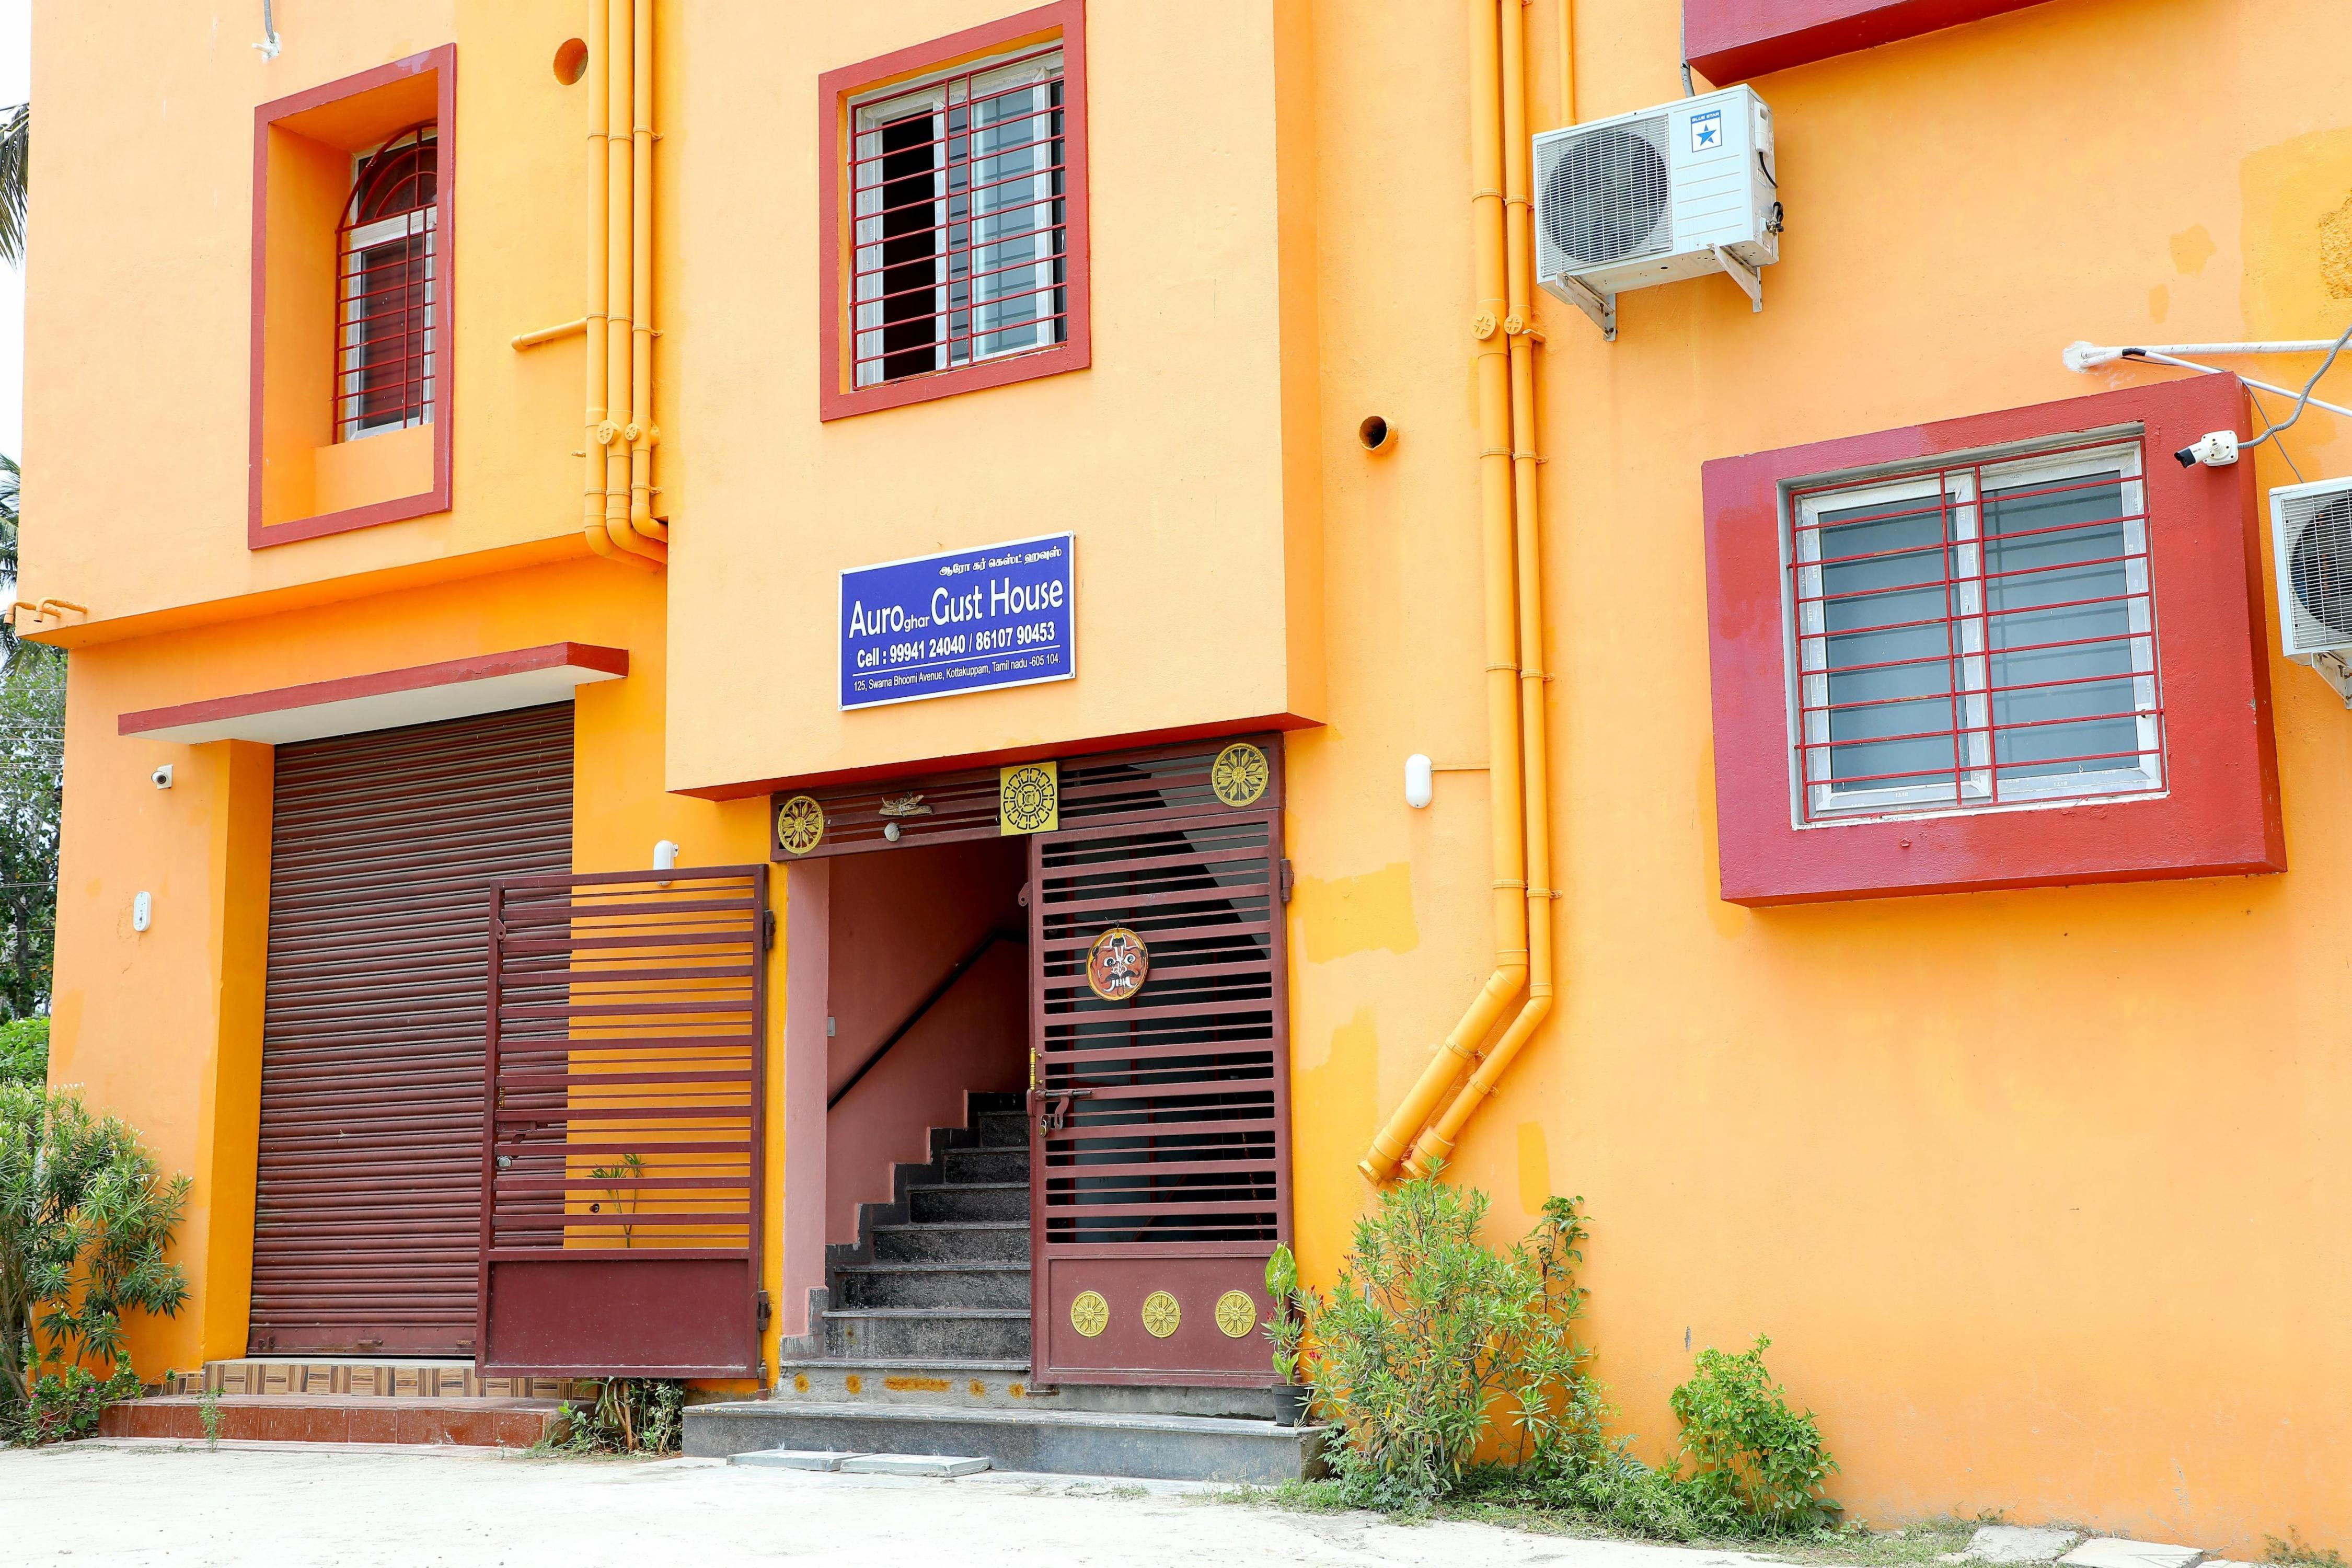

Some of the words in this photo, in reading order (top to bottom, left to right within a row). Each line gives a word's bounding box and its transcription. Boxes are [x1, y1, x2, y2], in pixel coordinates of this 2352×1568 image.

[939, 563, 971, 576] ஆரோ
[972, 558, 986, 571] கர்
[988, 554, 1023, 568] கெஸ்ட்
[931, 585, 983, 626] Gust
[990, 577, 1064, 617] House
[857, 647, 880, 668] Cell
[890, 640, 925, 664] 99941
[929, 634, 966, 658] 24040
[975, 627, 1013, 651] 86107
[1017, 621, 1055, 645] 90453
[854, 681, 867, 691] 125,
[868, 678, 892, 690] Swarna
[894, 673, 918, 686] Bhoomi
[918, 671, 944, 682] Avenue,
[946, 666, 990, 678] Kottakuppam,
[991, 660, 1009, 672] Tamil
[1010, 659, 1028, 670] nadu
